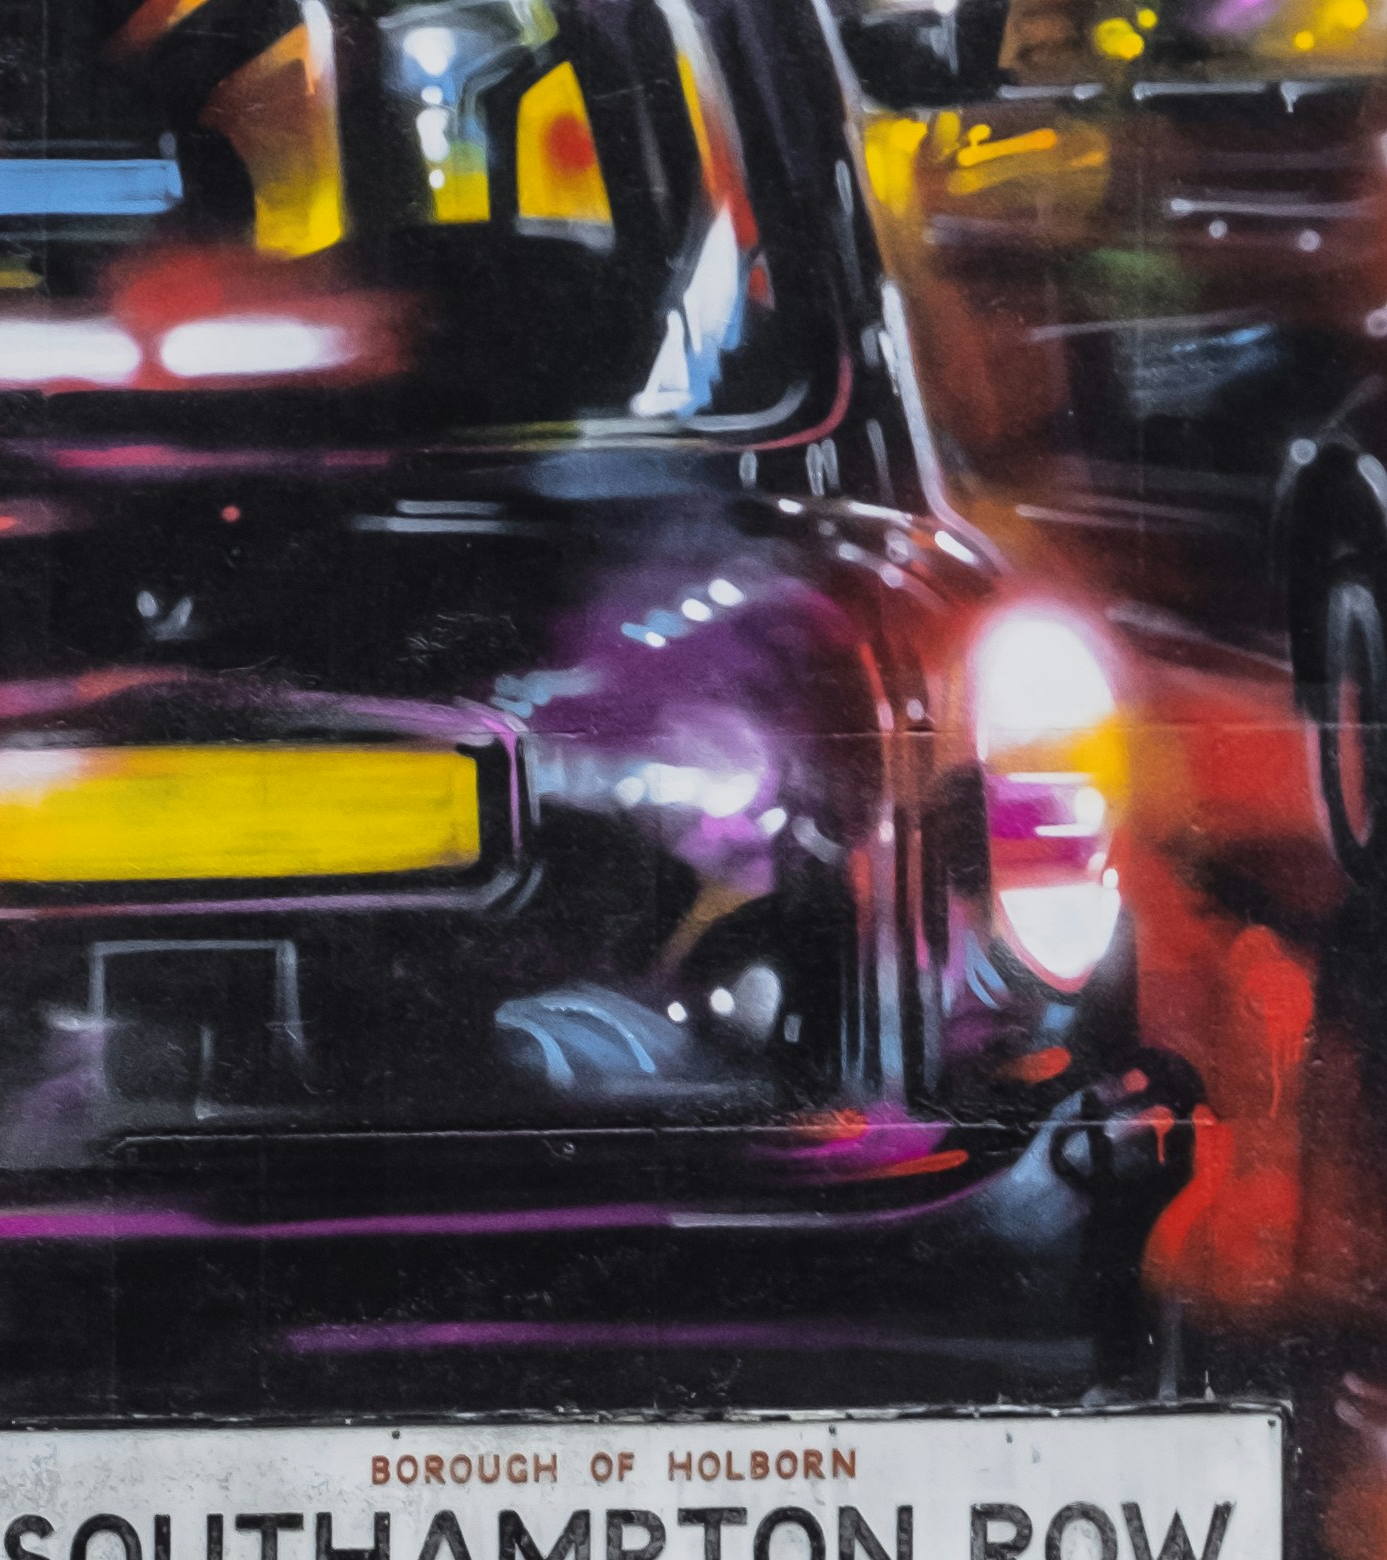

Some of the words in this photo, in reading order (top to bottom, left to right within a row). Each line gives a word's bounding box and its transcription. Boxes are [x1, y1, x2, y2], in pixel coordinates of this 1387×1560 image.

[370, 1452, 560, 1486] BOROUGH
[591, 1451, 637, 1484] OF
[667, 1448, 859, 1482] HOLBORN
